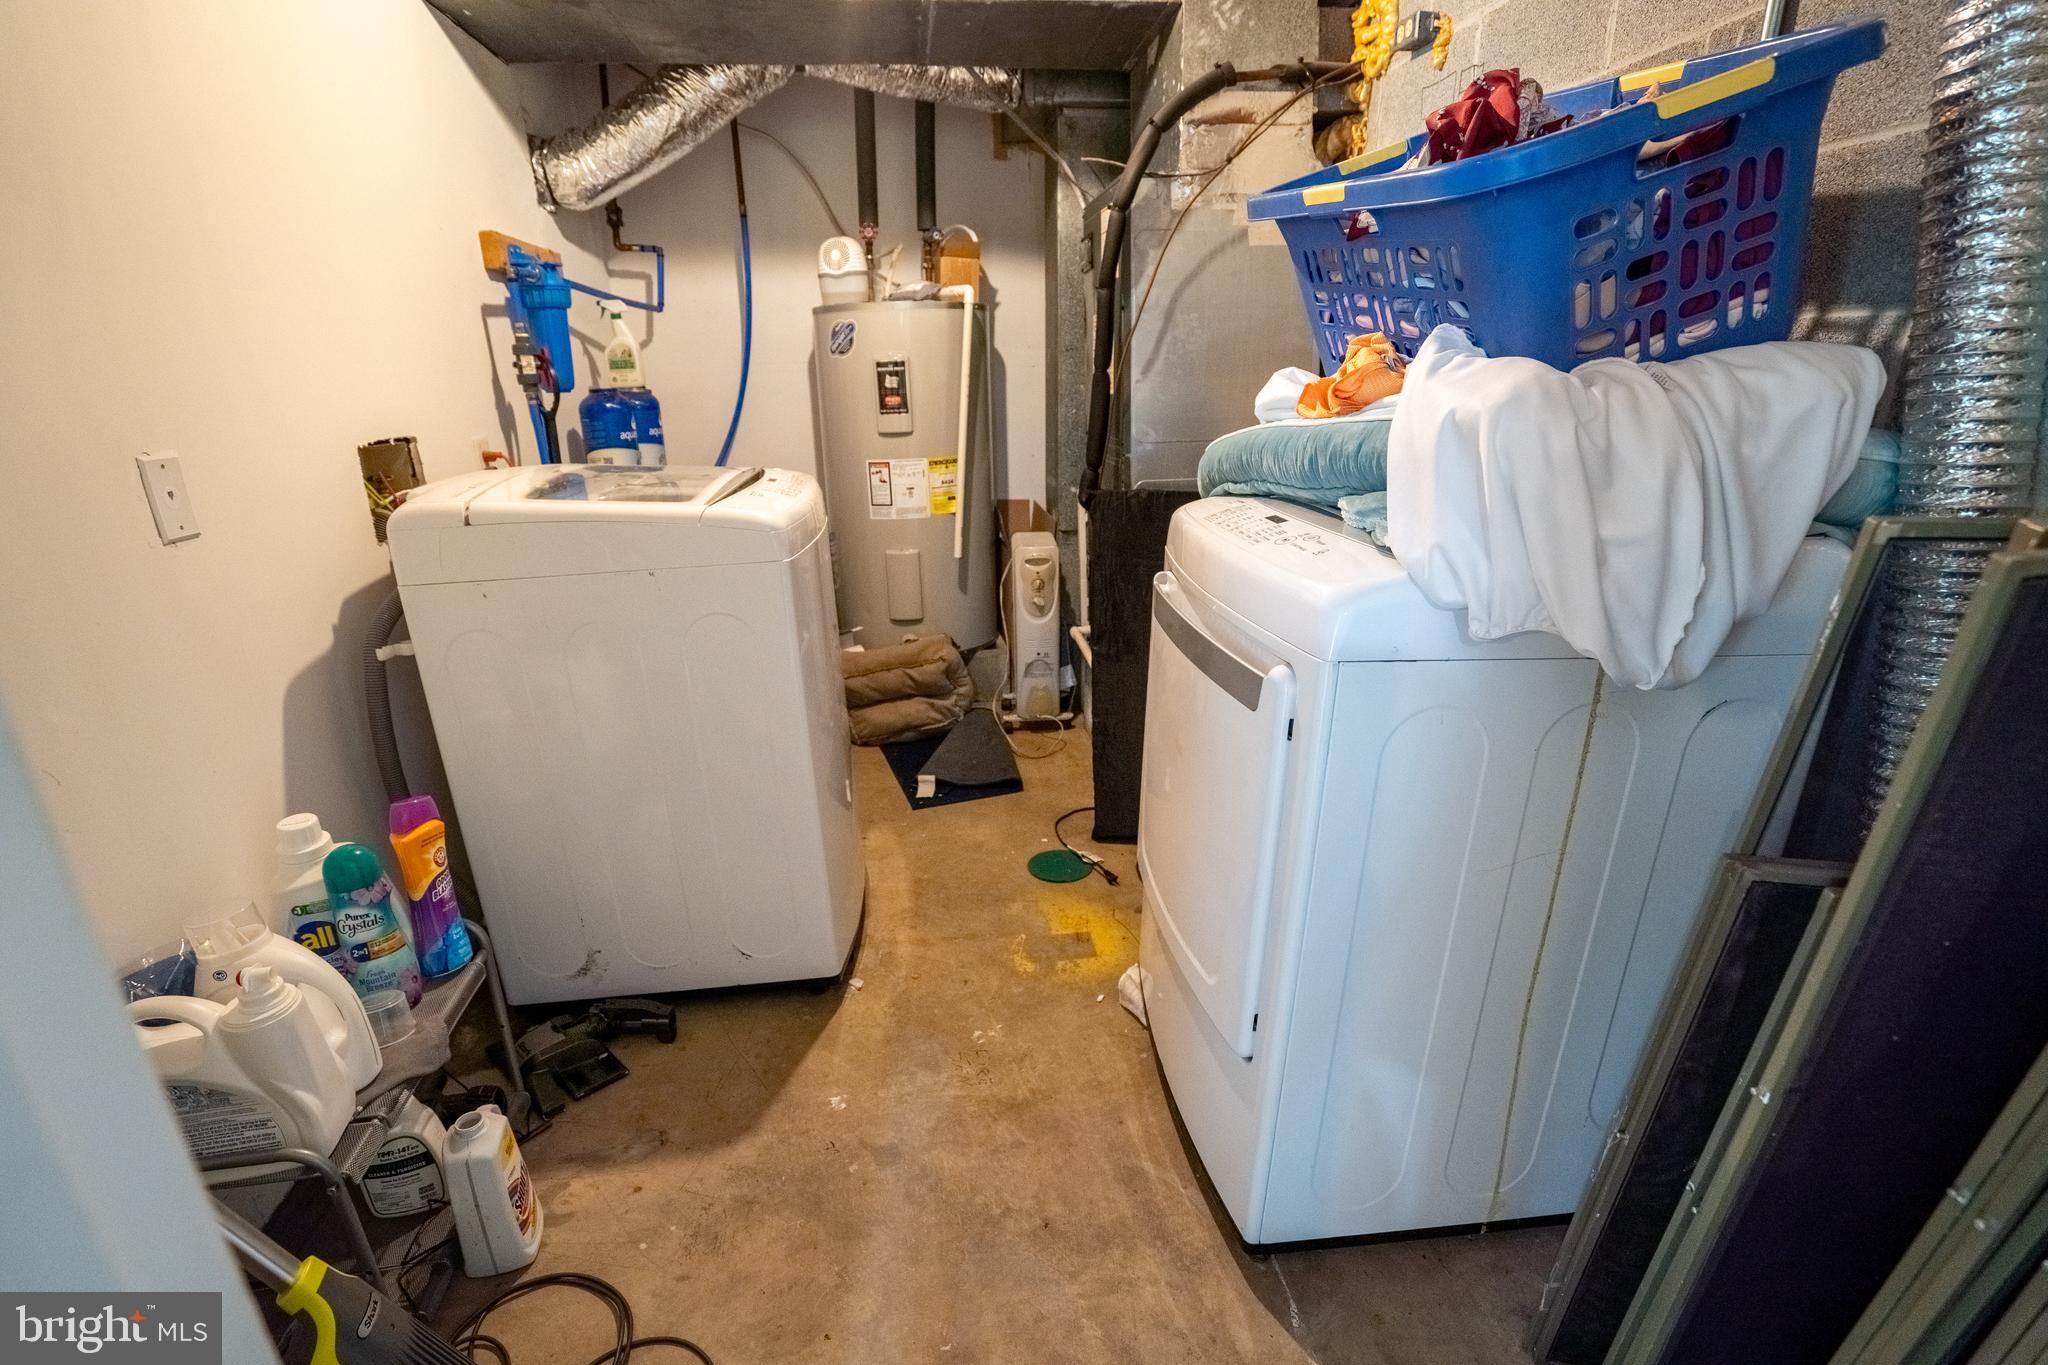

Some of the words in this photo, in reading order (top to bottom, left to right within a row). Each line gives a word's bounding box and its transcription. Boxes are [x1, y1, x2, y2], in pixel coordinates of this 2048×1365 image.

[337, 915, 385, 938] Crystals
[344, 912, 371, 922] Purex
[301, 926, 336, 950] all
[359, 971, 397, 986] Mountain
[366, 981, 393, 993] Breeze
[365, 1300, 378, 1329] Shark
